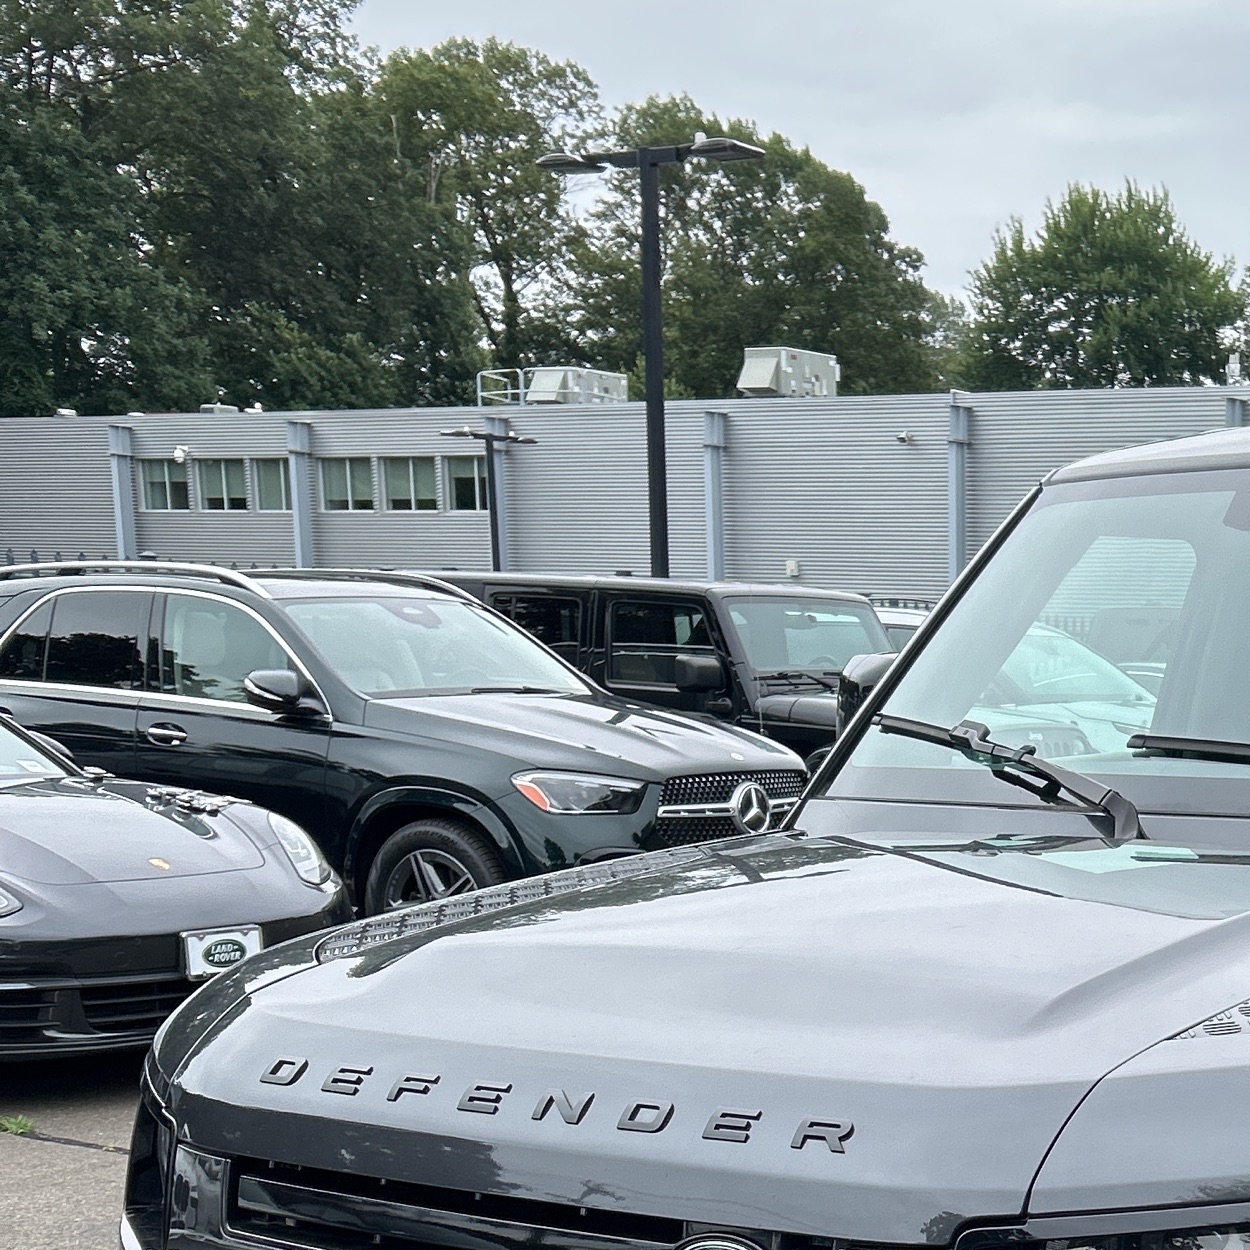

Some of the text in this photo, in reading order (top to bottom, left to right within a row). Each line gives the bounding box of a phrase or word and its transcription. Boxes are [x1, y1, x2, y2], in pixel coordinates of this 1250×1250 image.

[211, 943, 234, 954] LAND
[213, 951, 241, 963] ROVER
[260, 1054, 855, 1153] DEFENDER
